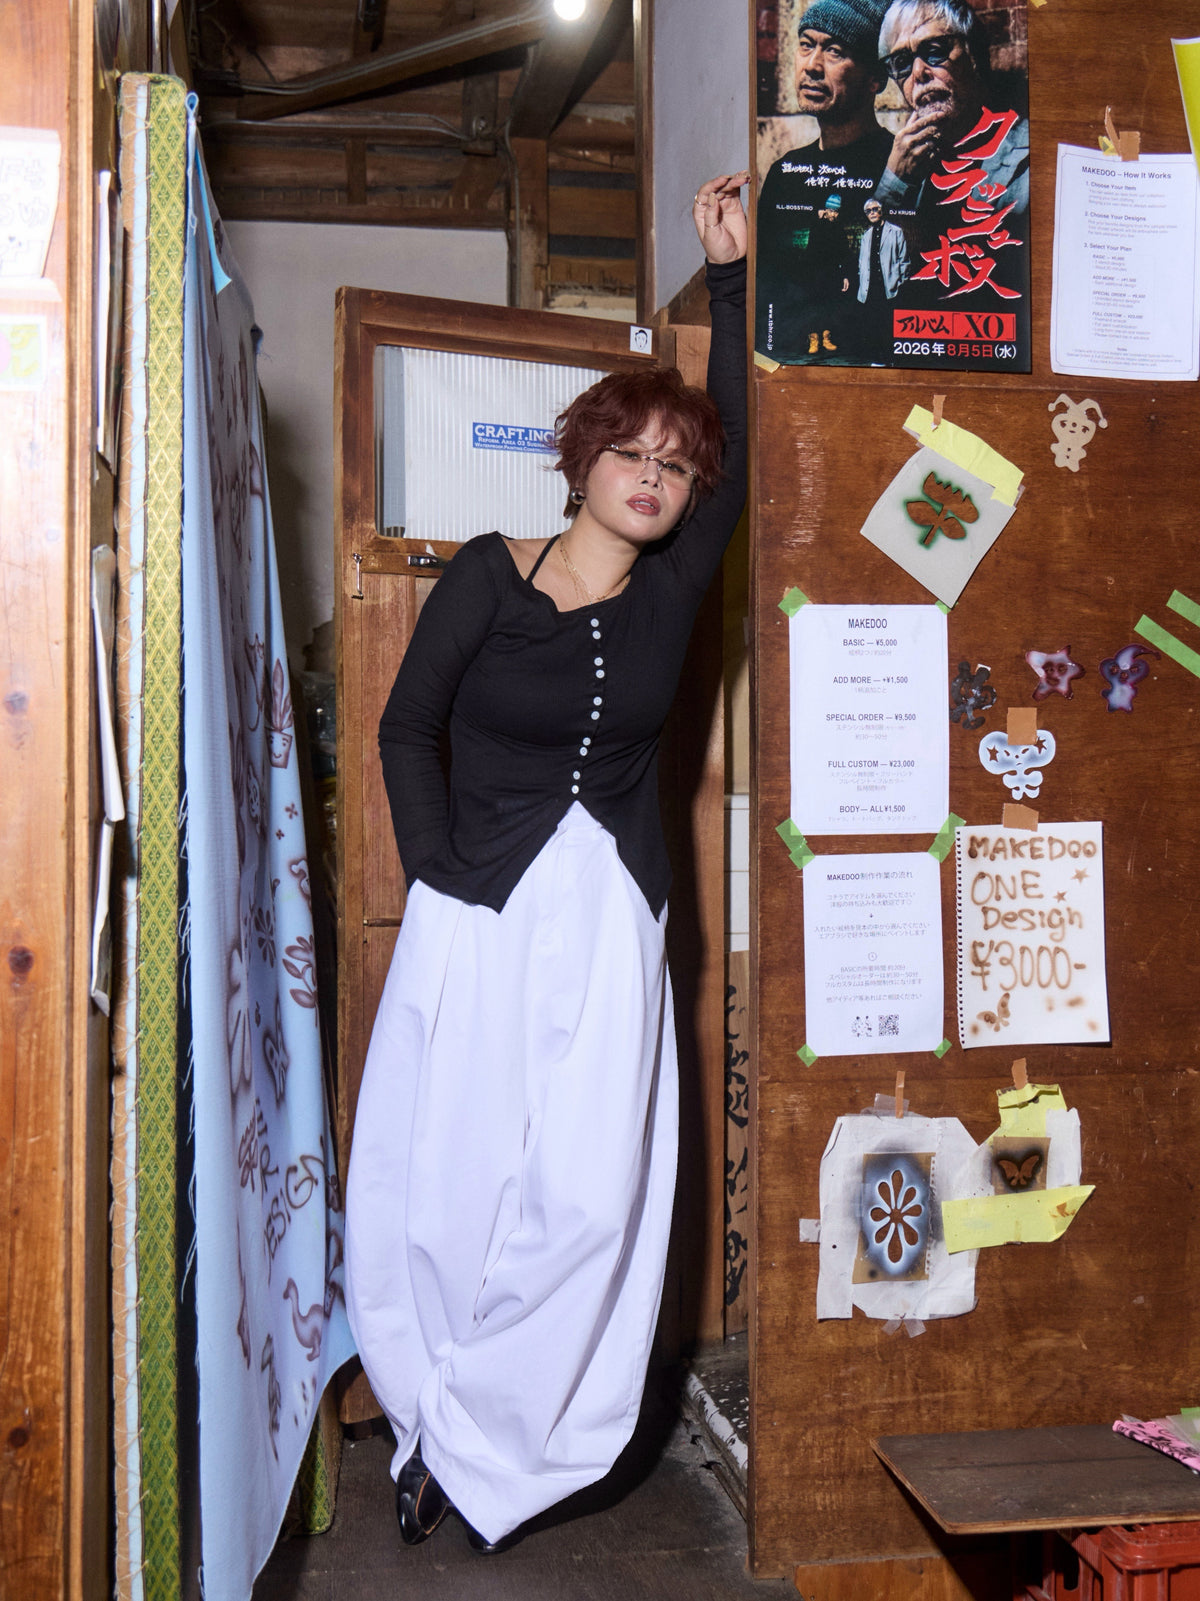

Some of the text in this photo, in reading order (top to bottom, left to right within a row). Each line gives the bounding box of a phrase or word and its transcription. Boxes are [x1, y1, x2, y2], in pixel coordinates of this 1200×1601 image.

[1081, 166, 1116, 178] MAKEDOO
[1123, 171, 1140, 179] How
[1147, 172, 1172, 180] Works
[1090, 181, 1111, 189] Choose
[1090, 211, 1110, 219] Choose
[1110, 213, 1123, 221] Your
[1123, 214, 1147, 223] Designs
[848, 618, 888, 629] MAKEDOO
[842, 638, 865, 647] BASIC
[876, 638, 898, 647] ¥5,000
[833, 676, 849, 684] ADD
[850, 676, 872, 684] MORE
[882, 676, 909, 685] +¥1,500
[826, 713, 856, 721] SPECIAL
[858, 713, 884, 721] ORDER
[894, 713, 917, 722] ¥9,500
[828, 760, 846, 768] FULL
[847, 760, 879, 768] CUSTOM
[889, 760, 915, 769] ¥23,000
[971, 869, 1044, 906] ONE
